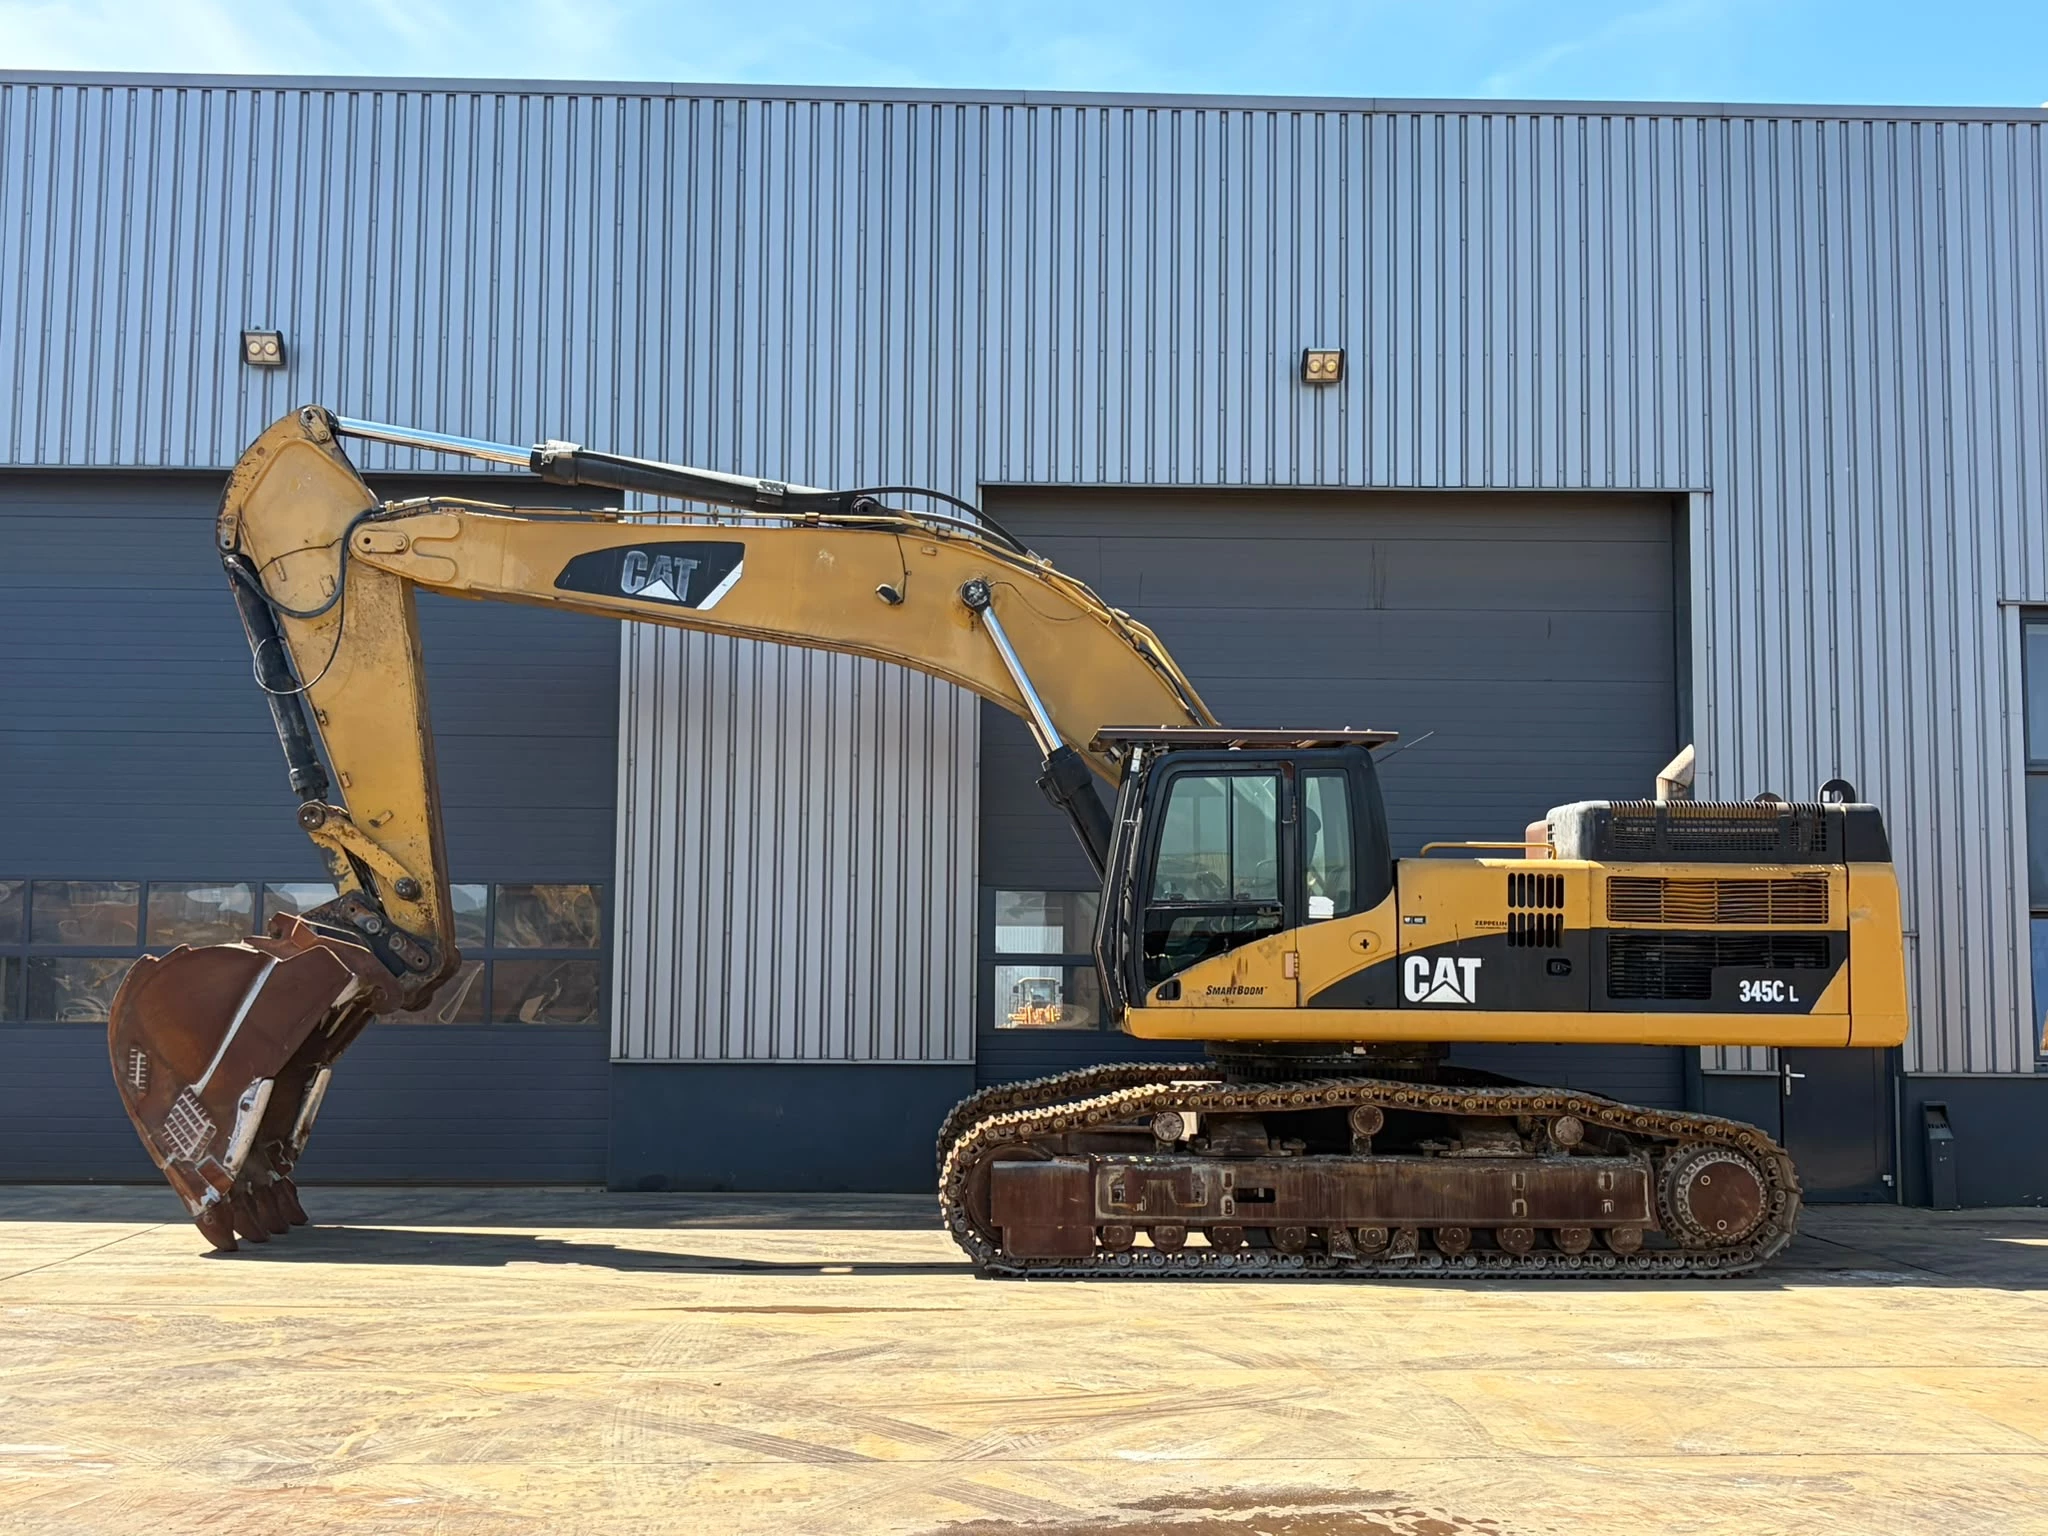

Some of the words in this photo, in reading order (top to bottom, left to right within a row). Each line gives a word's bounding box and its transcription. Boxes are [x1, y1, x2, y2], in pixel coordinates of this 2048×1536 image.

[621, 550, 699, 602] CAT
[1404, 955, 1482, 1004] CAT
[1739, 980, 1784, 1002] 345C
[1789, 985, 1799, 1002] L
